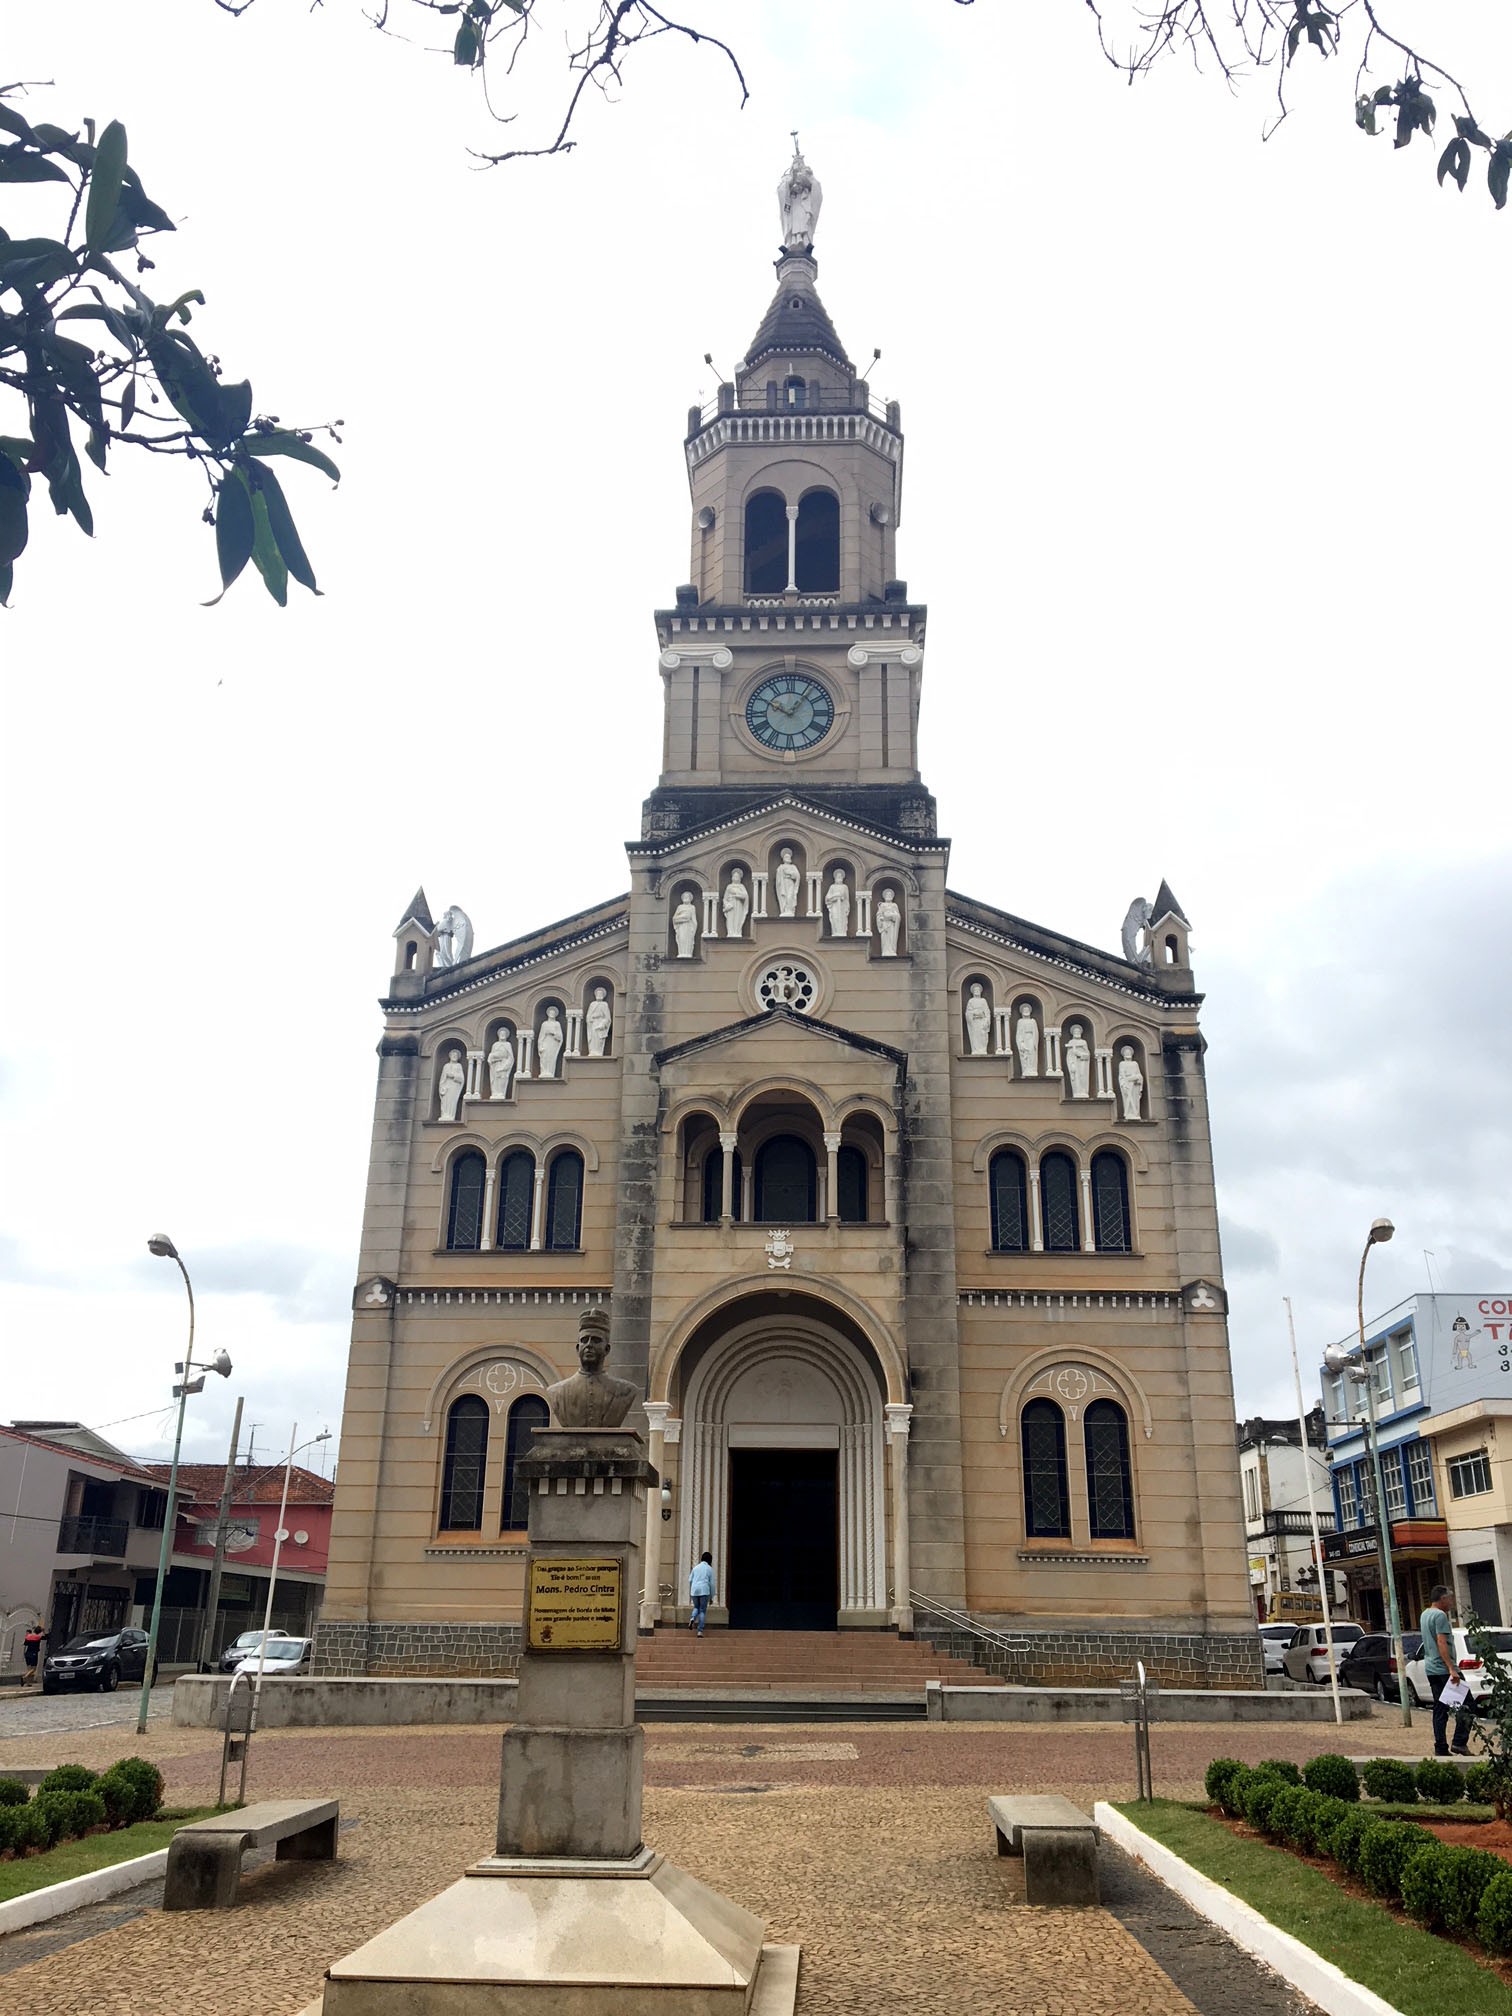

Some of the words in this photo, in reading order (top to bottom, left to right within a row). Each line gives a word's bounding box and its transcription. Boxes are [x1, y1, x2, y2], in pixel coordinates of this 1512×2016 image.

[1478, 1300, 1512, 1315] CO
[1483, 1323, 1512, 1340] T
[536, 1585, 562, 1594] Mons.
[564, 1585, 589, 1593] Pedro
[590, 1584, 615, 1593] Cintra
